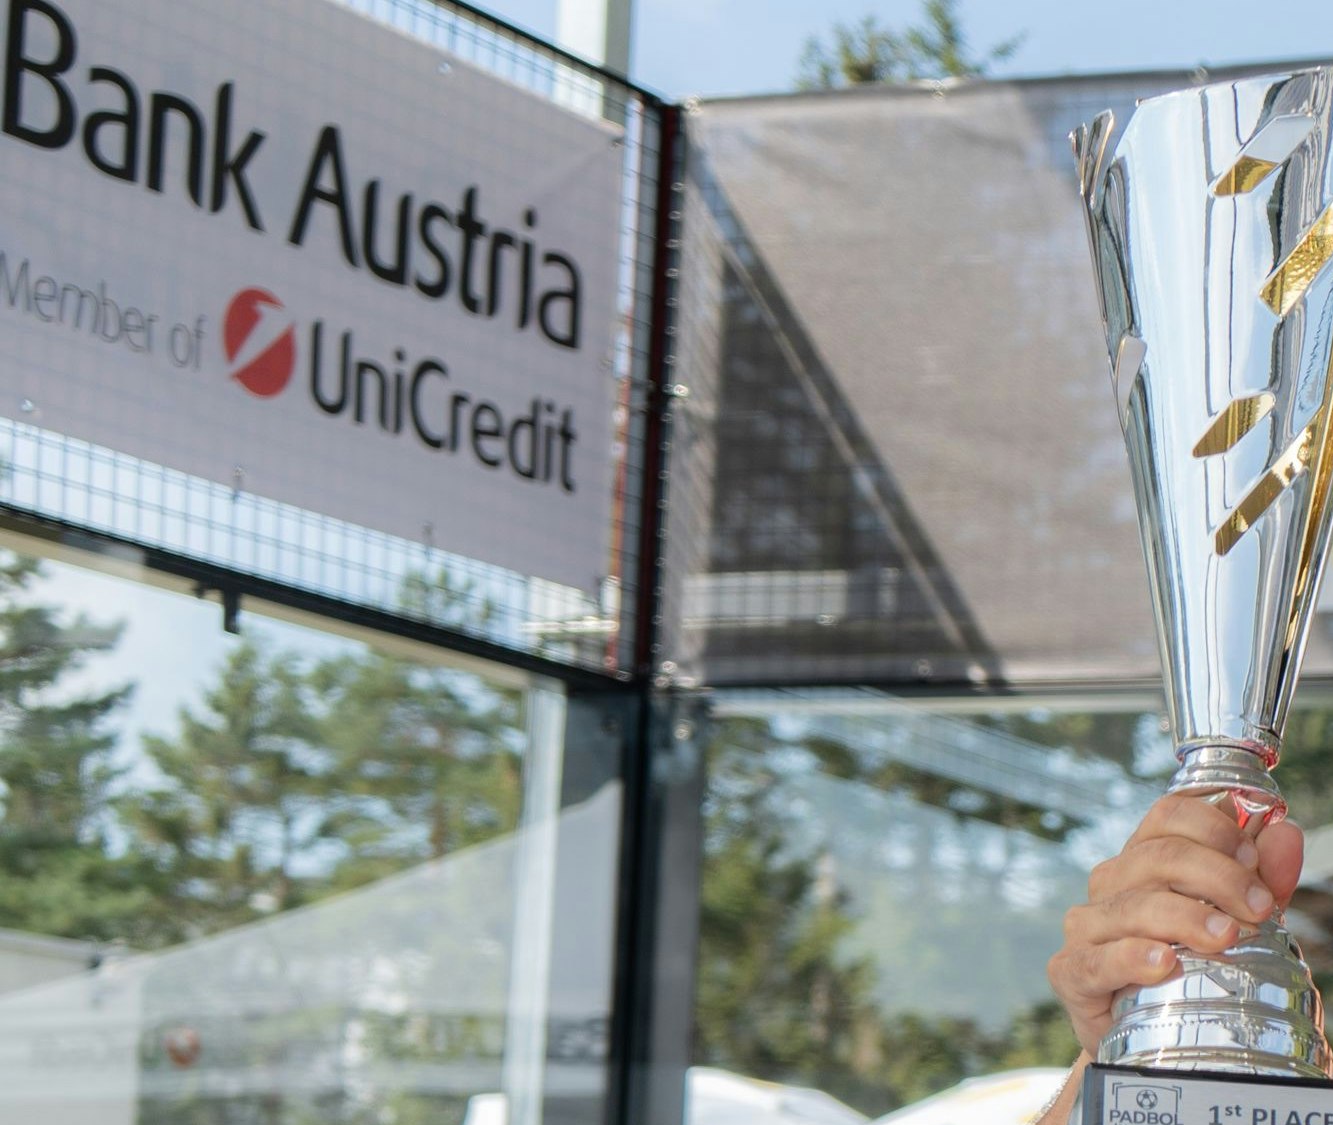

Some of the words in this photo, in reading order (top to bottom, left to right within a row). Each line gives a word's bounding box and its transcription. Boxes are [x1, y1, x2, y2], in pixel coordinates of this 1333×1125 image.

[2, 0, 267, 233] Bank
[288, 125, 582, 349] Austria
[0, 251, 159, 355] Member
[169, 313, 208, 373] of
[308, 320, 577, 494] UniCredit
